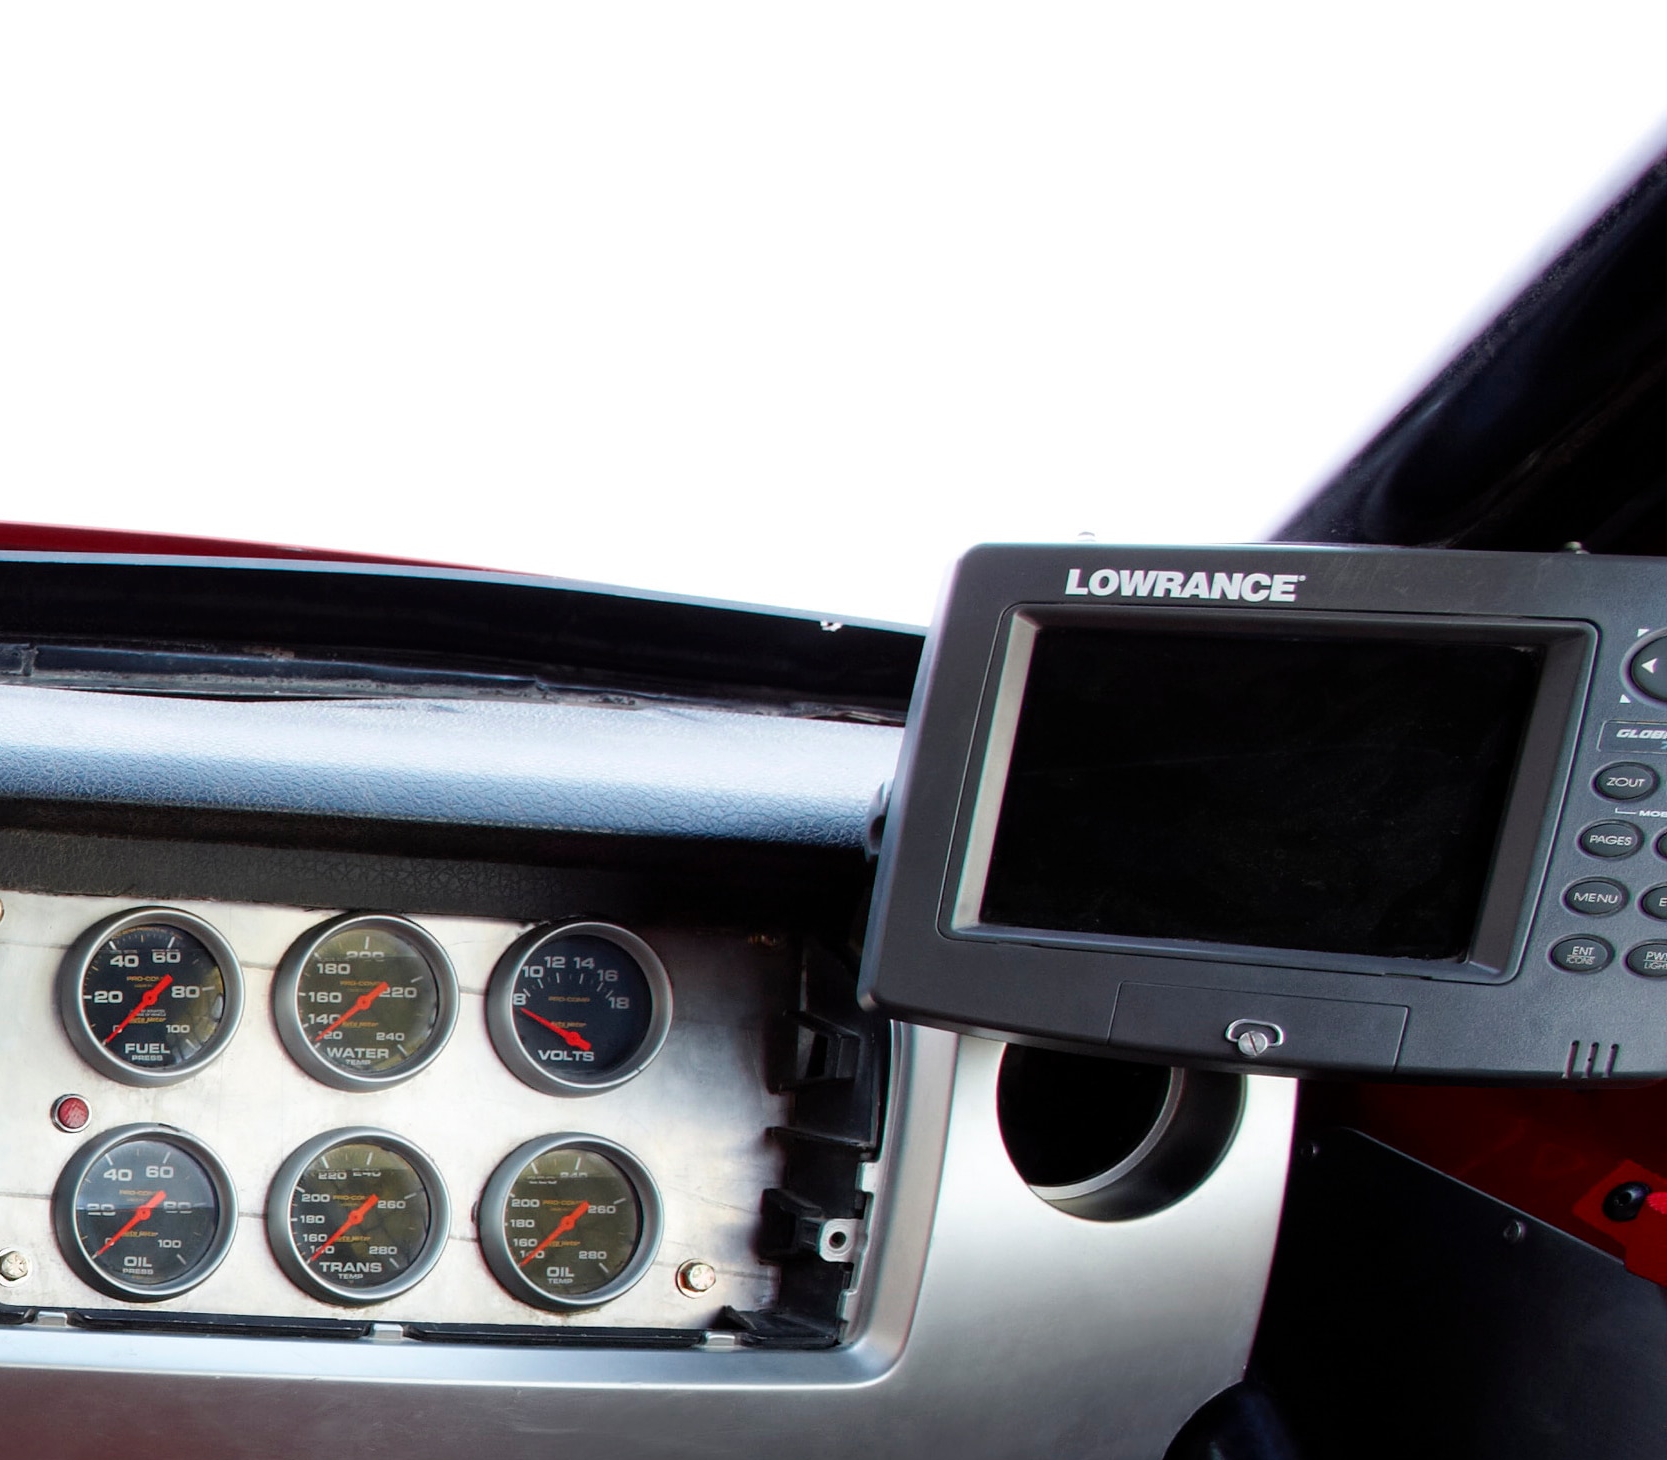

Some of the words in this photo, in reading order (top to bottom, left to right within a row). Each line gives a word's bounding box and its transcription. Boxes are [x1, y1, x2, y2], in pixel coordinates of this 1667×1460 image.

[1065, 568, 1300, 603] LOWRANCE
[1606, 777, 1645, 788] ZOUT
[1589, 835, 1632, 846] PAGES
[1573, 892, 1619, 904] MENU
[152, 950, 181, 963] 60
[1572, 946, 1595, 956] ENT
[110, 955, 139, 967] 40
[544, 956, 565, 968] 12
[574, 957, 595, 969] 14
[317, 963, 350, 974] 180
[522, 966, 544, 978] 10
[597, 969, 618, 981] 16
[94, 991, 123, 1003] 20
[171, 986, 200, 998] 80
[308, 992, 342, 1003] 160
[512, 993, 526, 1006] 8
[608, 997, 629, 1009] 18
[166, 1024, 190, 1033] 100
[376, 1032, 405, 1041] 240
[125, 1043, 170, 1054] FUEL
[327, 1048, 389, 1058] WATER
[538, 1050, 595, 1062] VOLTS
[103, 1168, 132, 1181] 40
[146, 1166, 174, 1178] 60
[301, 1194, 330, 1202] 200
[511, 1199, 540, 1207] 200
[377, 1200, 406, 1209] 260
[587, 1205, 616, 1214] 260
[300, 1215, 325, 1223] 180
[510, 1219, 535, 1227] 180
[158, 1239, 181, 1248] 100
[302, 1234, 327, 1242] 160
[513, 1238, 537, 1247] 160
[369, 1246, 397, 1254] 280
[579, 1251, 607, 1259] 280
[124, 1256, 152, 1267] OIL
[319, 1262, 382, 1272] TRANS
[547, 1267, 575, 1277] OIL
